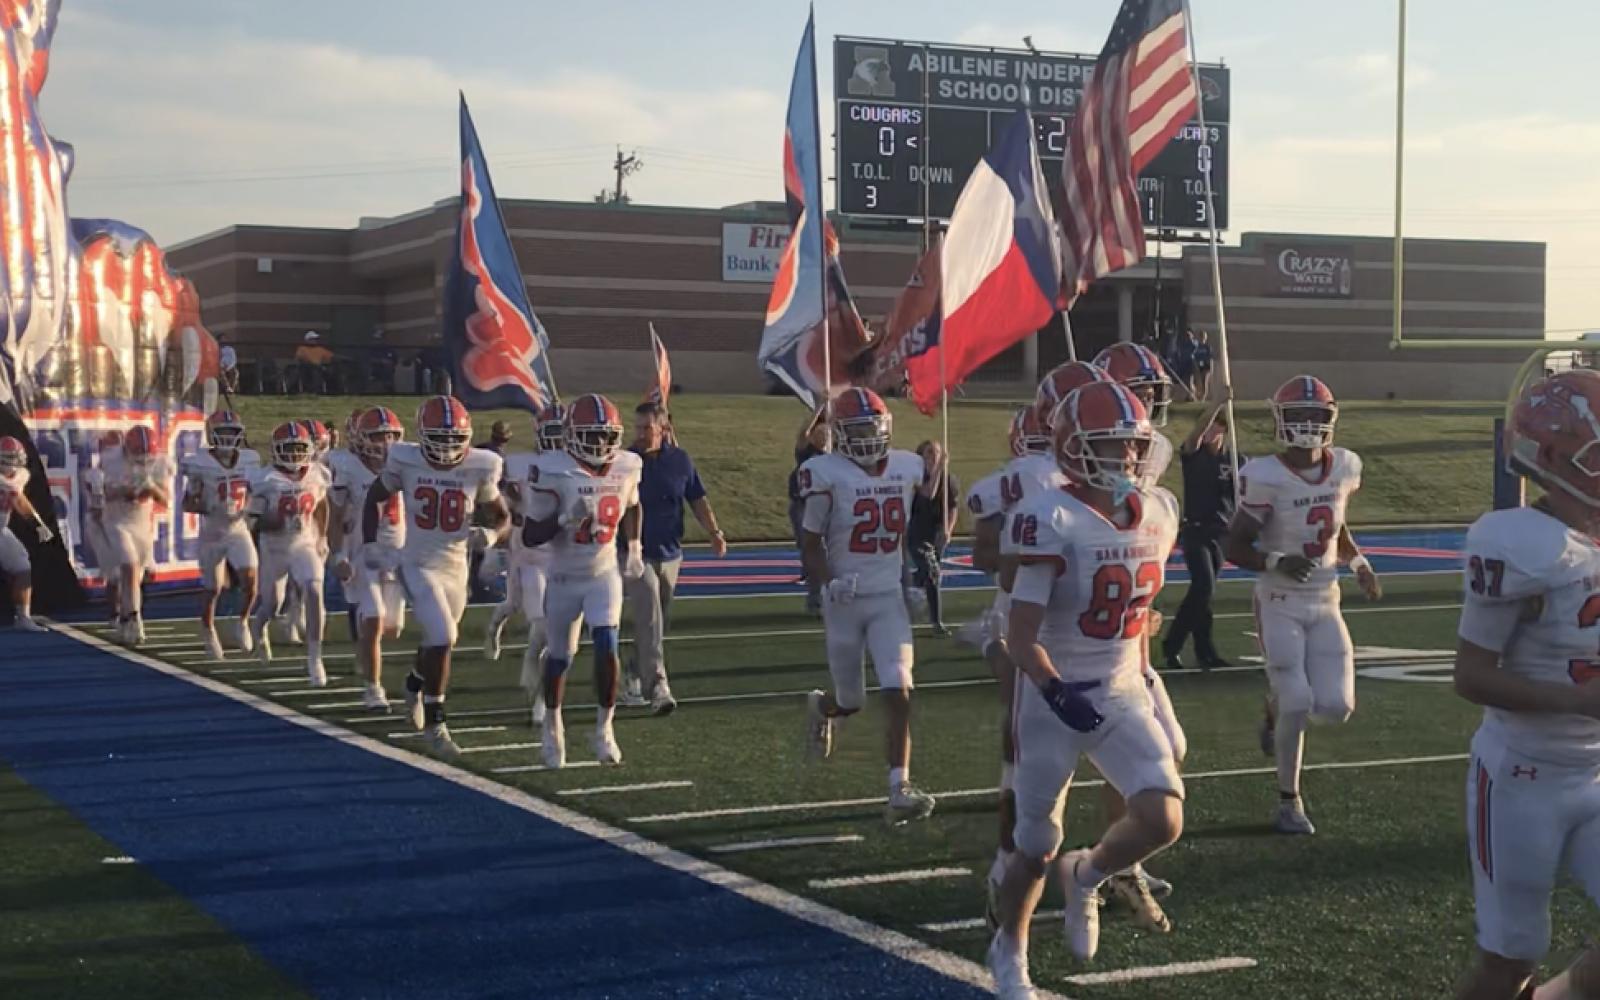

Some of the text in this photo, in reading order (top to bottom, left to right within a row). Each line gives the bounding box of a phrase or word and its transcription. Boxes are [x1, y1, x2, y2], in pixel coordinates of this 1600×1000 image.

[907, 53, 1007, 78] ABILENE
[850, 105, 922, 124] COUGARS
[879, 126, 895, 156] 0
[851, 162, 891, 180] T.O.L.
[909, 164, 953, 184] DOWN
[865, 185, 877, 208] 3
[1195, 200, 1206, 222] 3
[727, 255, 772, 271] Bank
[1279, 248, 1341, 276] CRAZY
[1294, 273, 1334, 285] WATER
[414, 486, 466, 533] 38
[849, 497, 906, 555] 29
[1303, 505, 1334, 559] 3
[1078, 561, 1163, 640] 82
